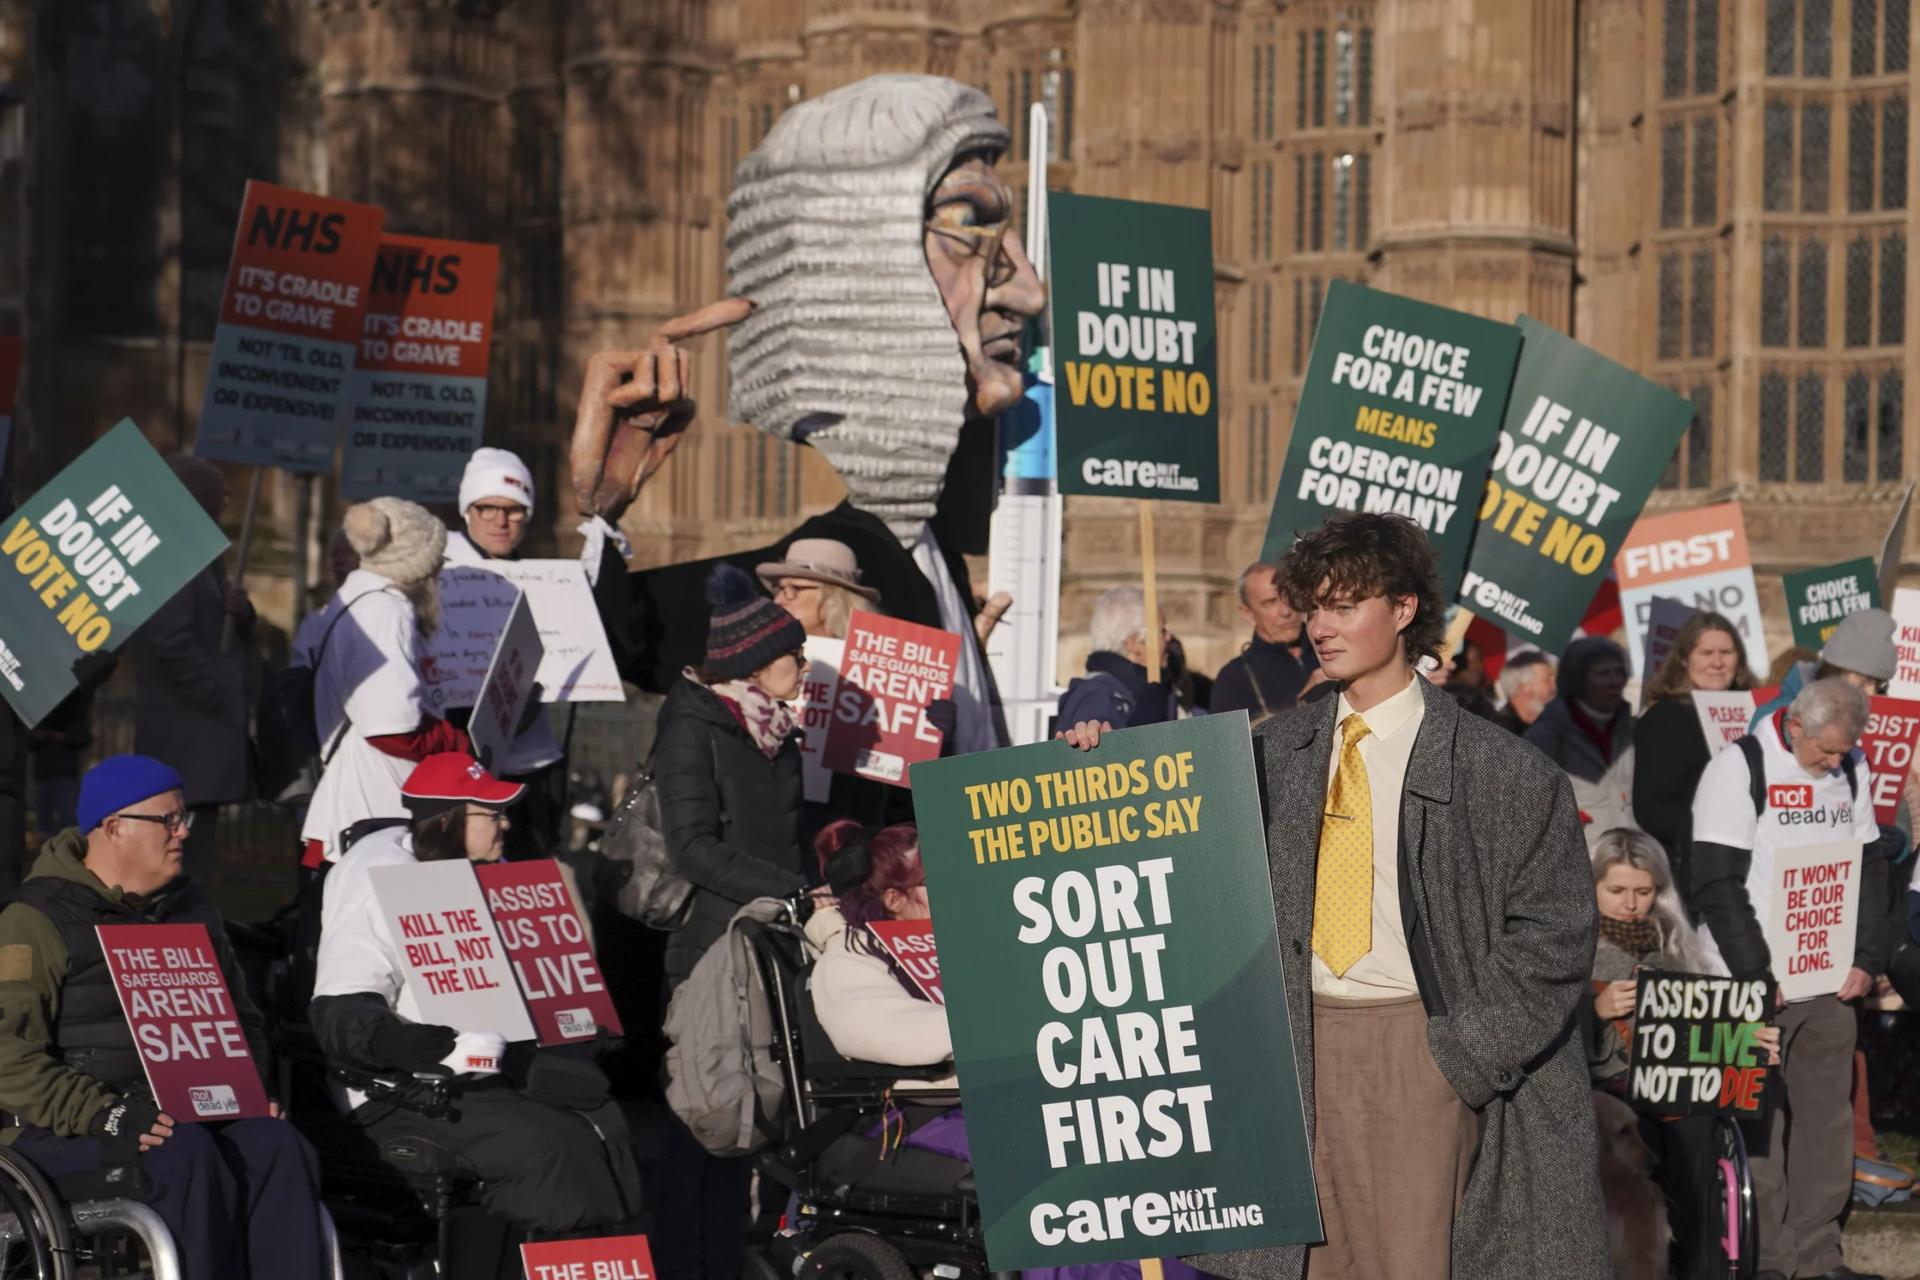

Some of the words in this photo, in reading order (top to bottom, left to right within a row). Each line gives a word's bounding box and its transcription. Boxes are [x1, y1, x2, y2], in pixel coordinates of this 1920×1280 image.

[247, 205, 346, 254] NHS
[238, 266, 275, 292] IT'S
[278, 273, 360, 307] CRADLE
[370, 254, 461, 295] NHS
[1097, 262, 1131, 308] IF
[1137, 266, 1176, 314] IN
[234, 293, 261, 317] TO
[266, 299, 335, 330] GRAVE
[402, 317, 483, 342] CRADLE
[238, 338, 272, 358] NOT
[362, 340, 387, 360] TO
[393, 343, 461, 366] GRAVE
[1078, 311, 1197, 365] DOUBT
[1363, 324, 1470, 380] CHOICE
[214, 388, 239, 406] OR
[218, 363, 341, 394] INCONVENIENT
[371, 382, 405, 398] NOT
[1065, 361, 1156, 411] VOTE
[1162, 369, 1211, 417] NO
[1332, 352, 1392, 396] FOR
[1393, 369, 1415, 402] A
[1419, 374, 1482, 418] FEW
[354, 407, 475, 428] INCONVENIENT
[1355, 405, 1438, 449] MEANS
[1521, 395, 1572, 444] IF
[1563, 417, 1620, 474] IN
[353, 432, 377, 449] OR
[1082, 457, 1158, 488] care
[1309, 436, 1463, 502] COERCION
[1298, 469, 1361, 512] FOR
[1363, 484, 1457, 534] MANY
[86, 484, 133, 526] IF
[110, 515, 161, 567] IN
[1477, 480, 1547, 546] OTE
[1540, 516, 1606, 576] NO
[39, 498, 141, 611] DOUBT
[1624, 529, 1735, 579] FIRST
[1, 517, 78, 609] VOTE
[57, 592, 111, 652] NO
[1694, 586, 1743, 612] NO
[1806, 575, 1859, 603] CHOICE
[1799, 602, 1830, 625] FOR
[1831, 600, 1841, 618] A
[1842, 591, 1871, 616] FEW
[849, 650, 949, 683] SAFEGUARDS
[854, 629, 898, 656] THE
[903, 642, 950, 669] BILL
[844, 665, 948, 704] ARENT
[835, 691, 940, 744] SAFE
[1708, 705, 1749, 722] PLEASE
[1872, 740, 1912, 768] TO
[965, 778, 1032, 822] TWO
[1035, 759, 1149, 809] THIRDS
[1154, 751, 1194, 791] OF
[1774, 787, 1807, 806] not
[968, 825, 1026, 865] THE
[1030, 809, 1140, 857] PUBLIC
[1146, 795, 1202, 839] SAY
[1778, 805, 1826, 825] dead
[1783, 868, 1798, 889] IT
[1802, 861, 1852, 886] WON'T
[487, 882, 566, 913] ASSIST
[1012, 856, 1174, 945] SORT
[1788, 889, 1808, 910] BE
[1812, 884, 1844, 906] OUR
[398, 912, 444, 938] KILL
[441, 909, 482, 933] THE
[496, 918, 541, 950] US
[540, 913, 583, 945] TO
[1786, 906, 1843, 931] CHOICE
[112, 948, 160, 970] THE
[161, 947, 214, 969] BILL
[405, 942, 457, 968] BILL,
[454, 937, 494, 961] NOT
[1798, 930, 1828, 952] FOR
[120, 971, 220, 988] SAFEGUARDS
[422, 969, 464, 995] THE
[463, 966, 500, 991] ILL.
[513, 953, 604, 1001] LIVE
[1041, 933, 1167, 1014] OUT
[1788, 951, 1834, 976] LONG.
[132, 987, 227, 1019] ARENT
[1639, 979, 1732, 1019] ASSIST
[1728, 980, 1767, 1022] US
[138, 1020, 248, 1063] SAFE
[1036, 1004, 1202, 1089] CARE
[1638, 1023, 1676, 1060] TO
[1689, 1022, 1766, 1067] LIVE
[192, 1090, 212, 1101] not
[198, 1100, 222, 1111] dead
[1633, 1065, 1688, 1103] NOT
[1689, 1066, 1722, 1103] TO
[1719, 1066, 1767, 1111] DIE
[1041, 1084, 1213, 1169] FIRST
[1030, 1191, 1171, 1247] care
[1169, 1187, 1217, 1212] NOT
[1172, 1204, 1264, 1234] KILLING
[534, 1263, 586, 1280] THE
[593, 1258, 649, 1280] BILL
